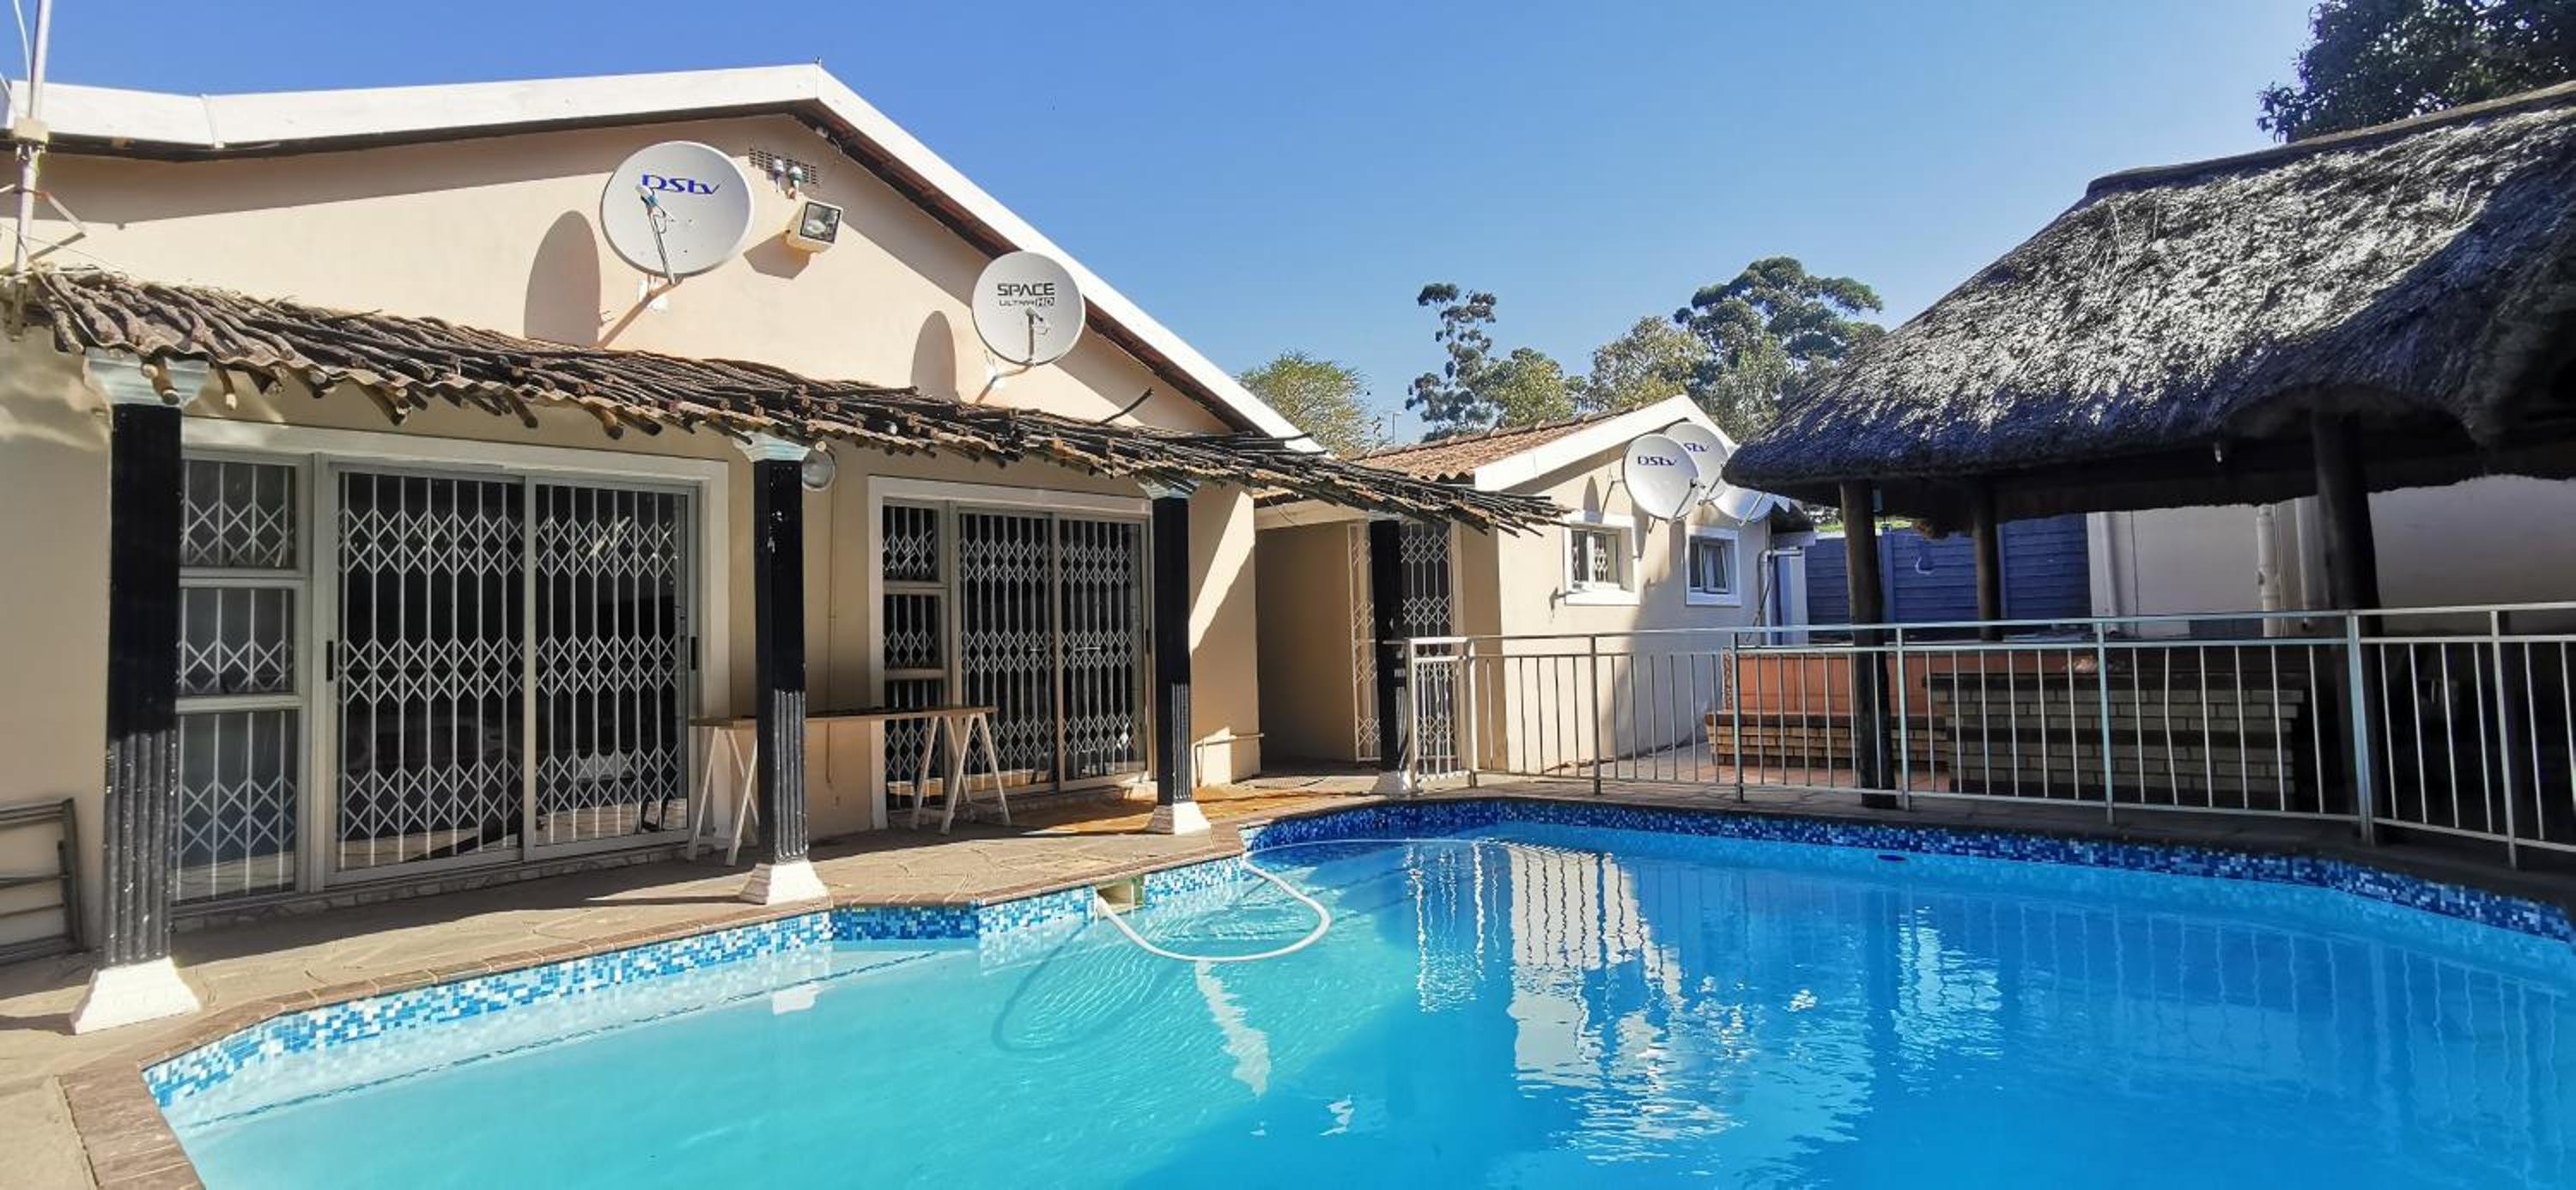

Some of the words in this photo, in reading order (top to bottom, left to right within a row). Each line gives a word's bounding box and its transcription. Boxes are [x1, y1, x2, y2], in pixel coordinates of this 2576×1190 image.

[641, 174, 724, 195] DStv
[997, 282, 1054, 296] SPACE
[1684, 442, 1710, 452] Stv
[1637, 456, 1677, 466] DStv
